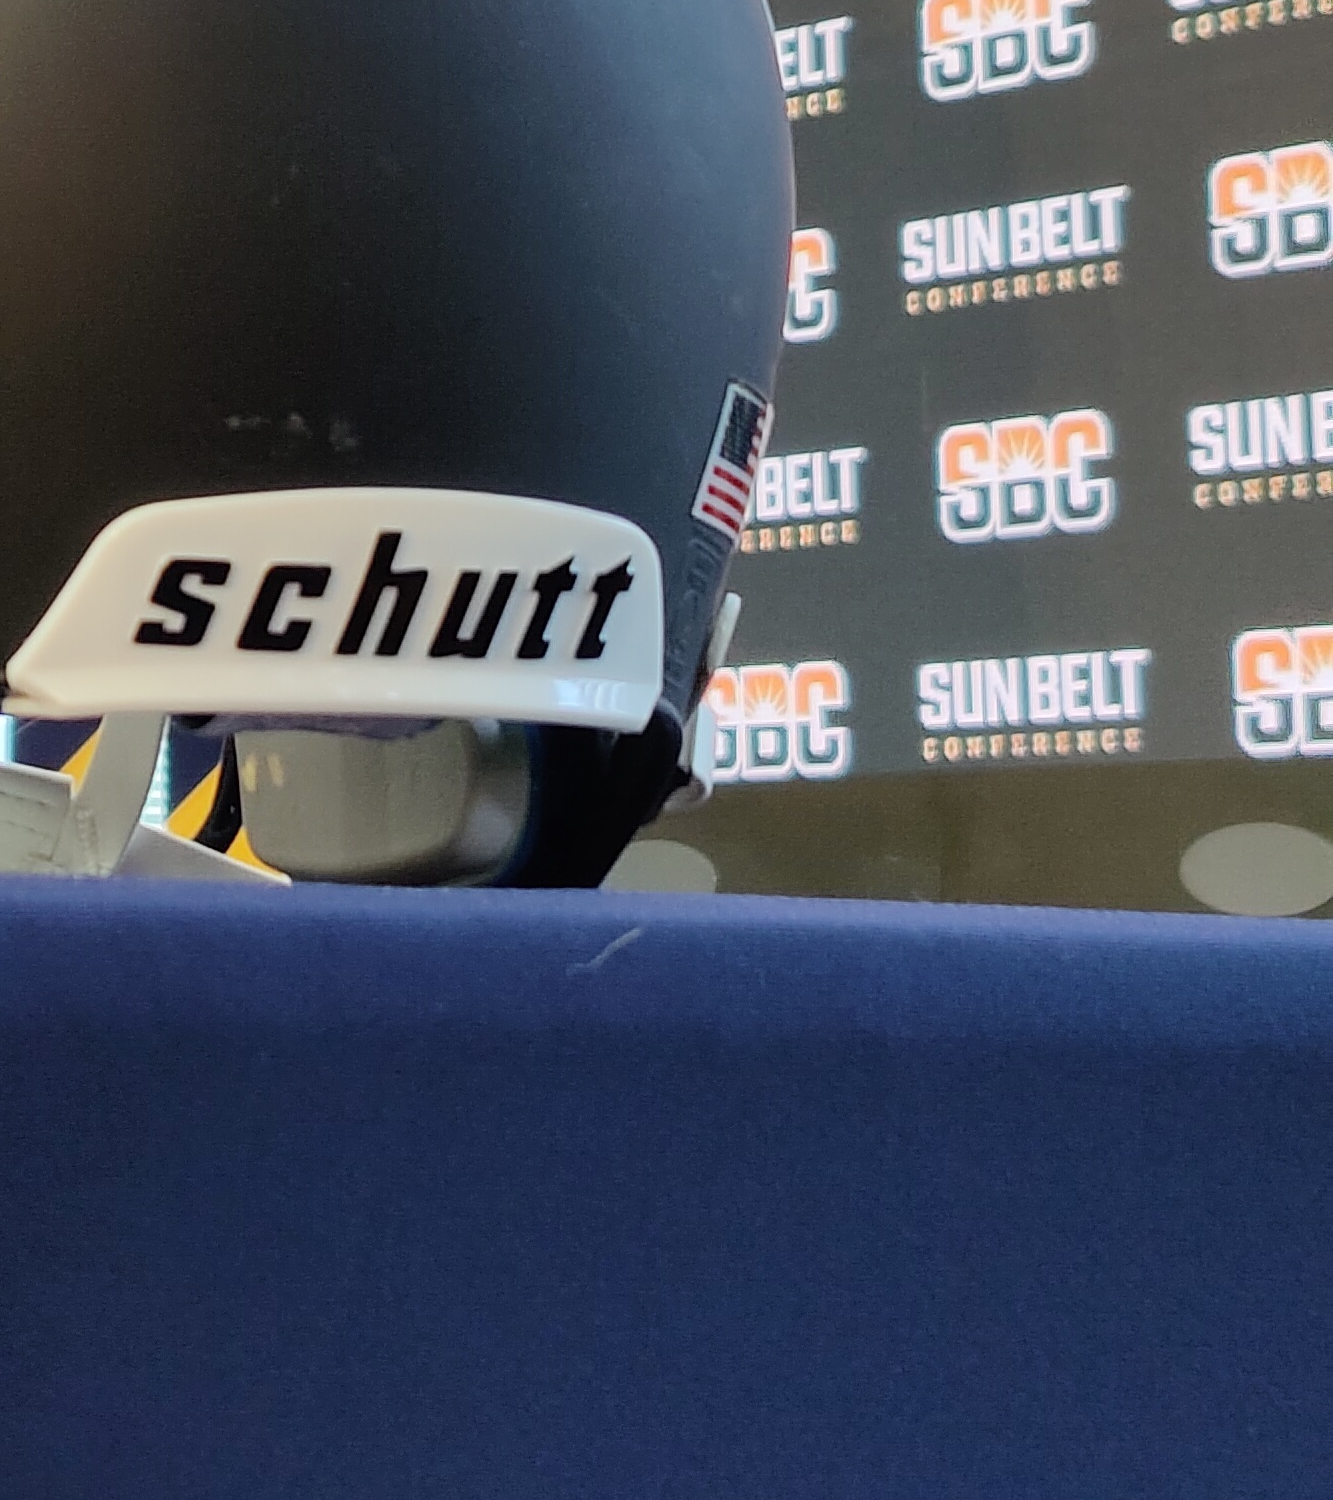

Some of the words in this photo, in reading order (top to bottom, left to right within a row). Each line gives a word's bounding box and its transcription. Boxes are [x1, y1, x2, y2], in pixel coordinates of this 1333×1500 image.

[774, 15, 855, 92] ELT
[900, 206, 1012, 285] SUN
[1010, 185, 1131, 270] BELT
[1207, 140, 1333, 279] SB
[906, 261, 1120, 313] CONFERENCE
[1187, 394, 1310, 476] SUN
[754, 446, 868, 521] BELT
[935, 409, 1117, 544] SBC
[134, 531, 634, 659] schutt
[916, 657, 1030, 731] SUN
[1028, 649, 1152, 729] BELT
[923, 727, 1142, 763] CONFERENCE
